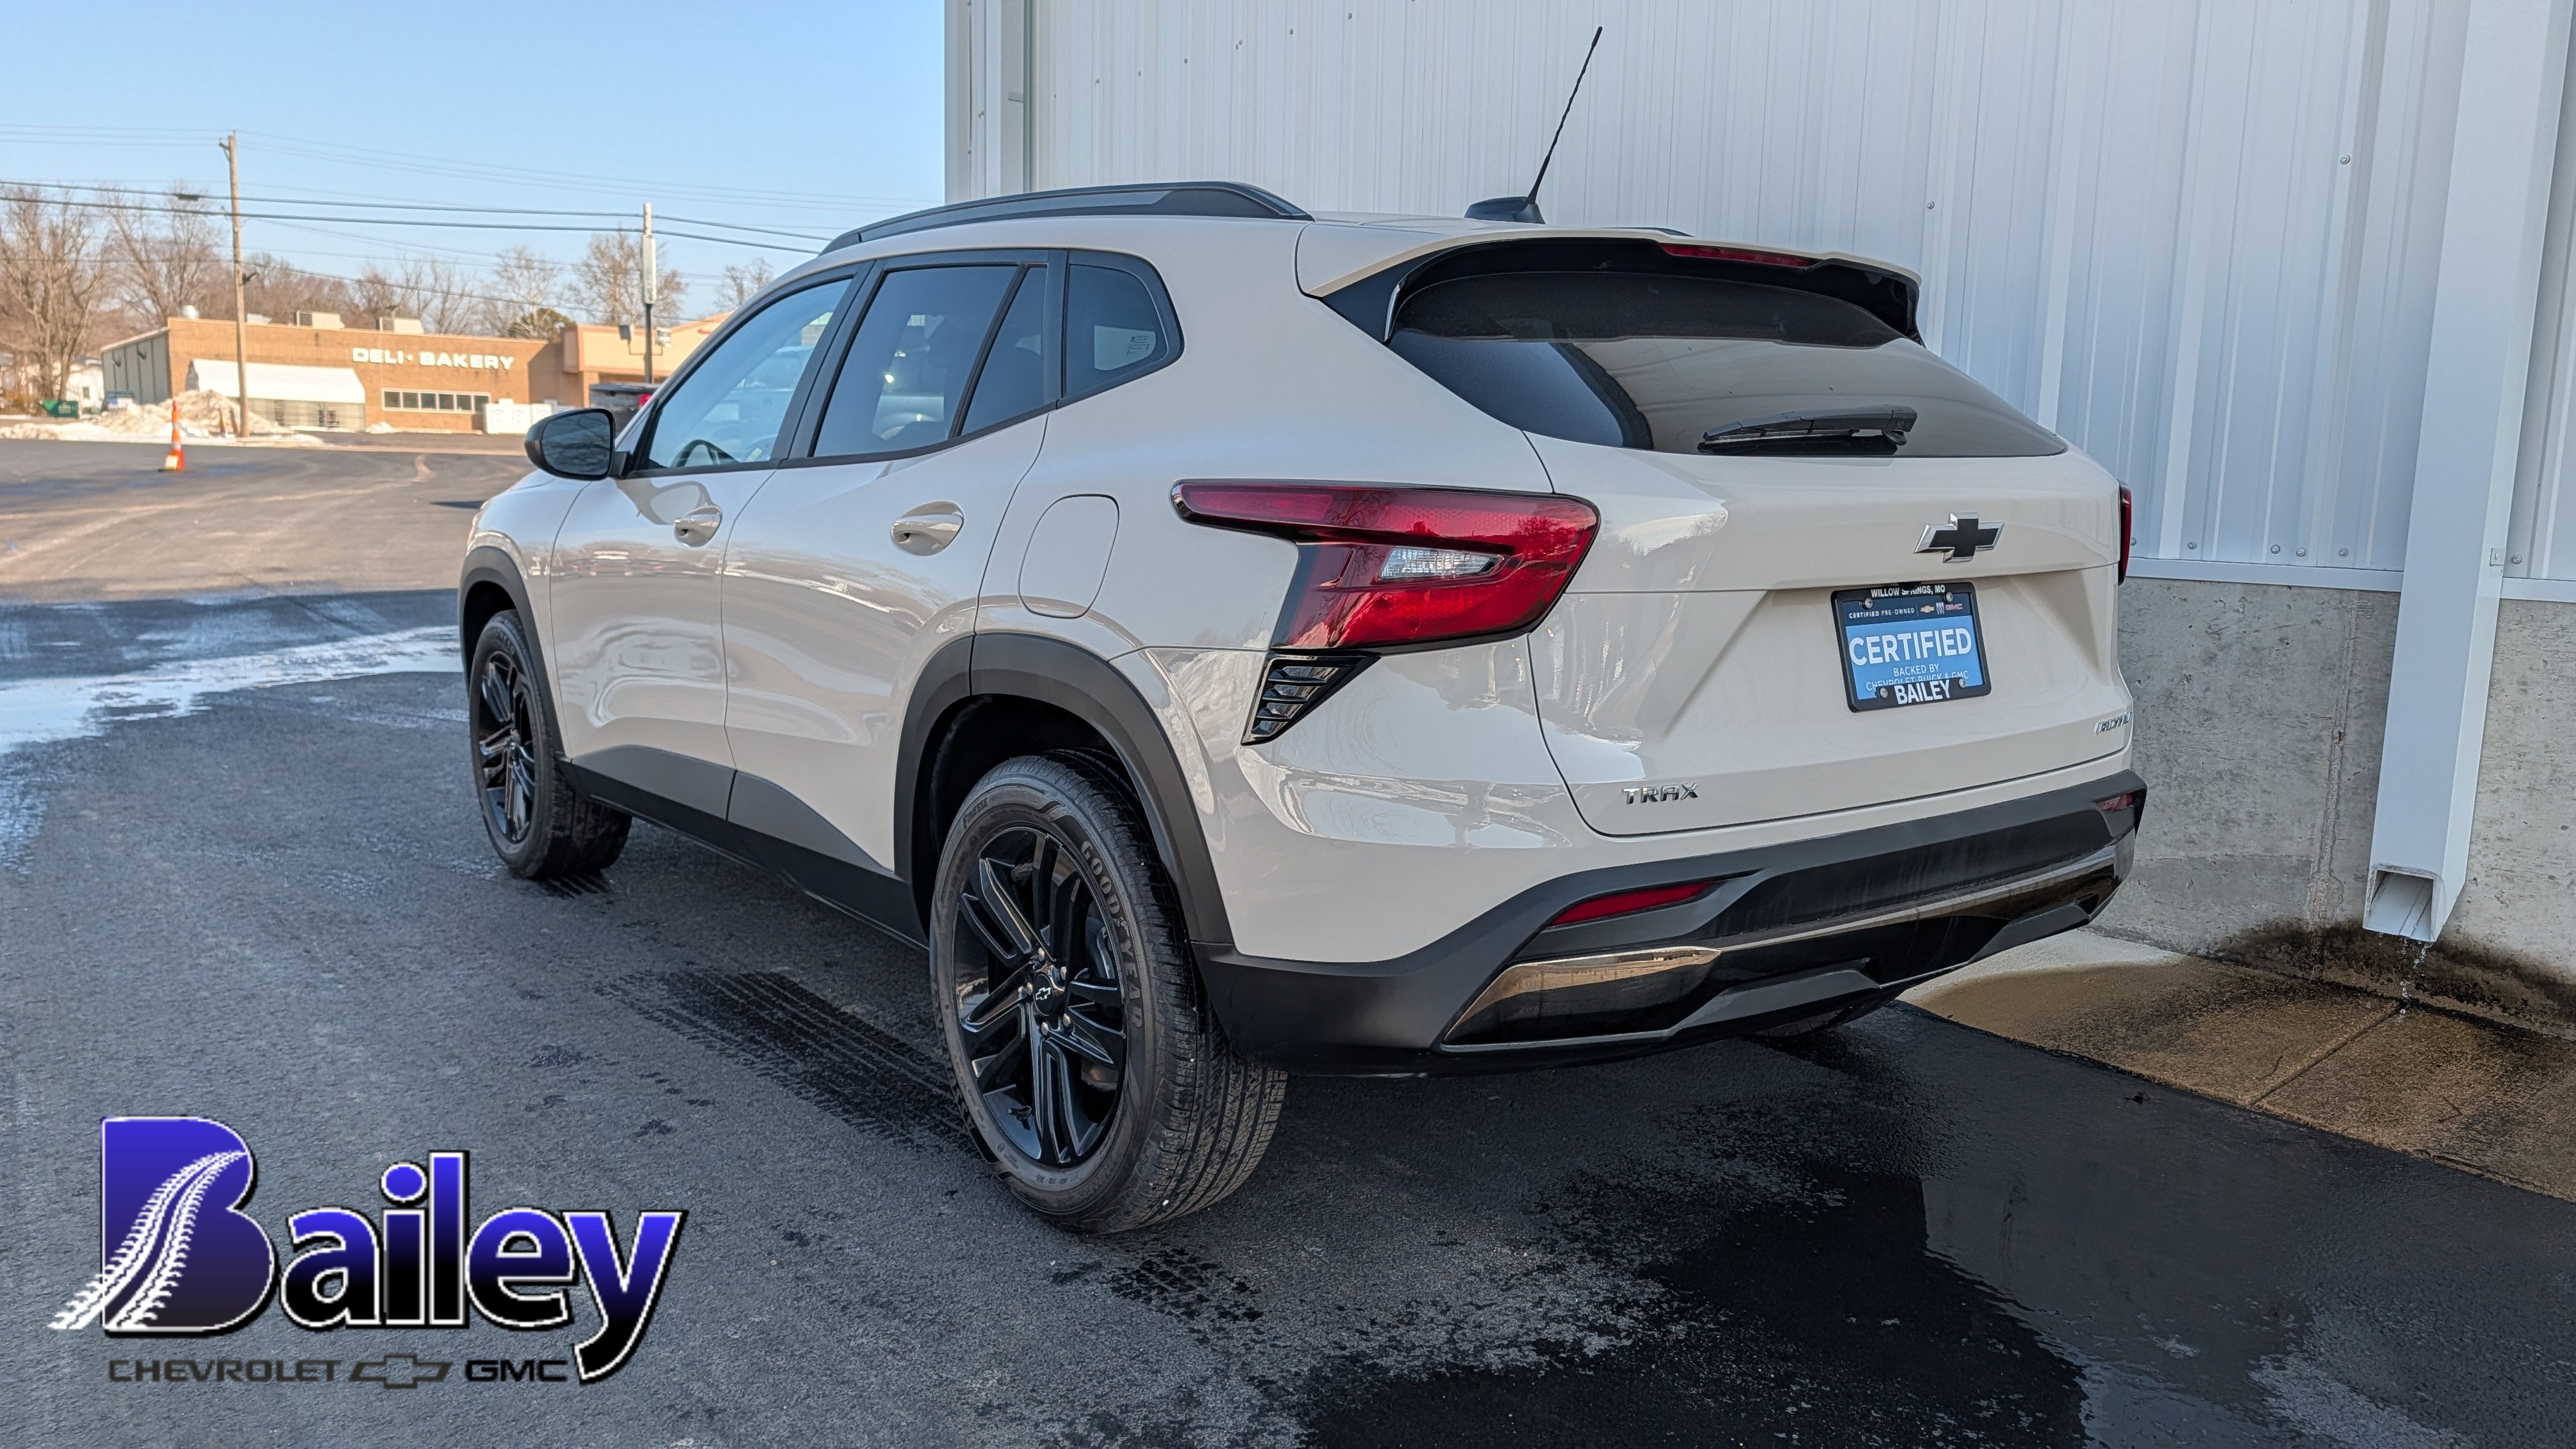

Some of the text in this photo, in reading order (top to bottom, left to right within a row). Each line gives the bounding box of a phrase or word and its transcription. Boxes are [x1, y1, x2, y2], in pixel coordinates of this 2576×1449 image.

[352, 347, 514, 371] DELI BAKERY
[1871, 587, 1900, 598] WILLOW
[1935, 584, 1946, 594] MO
[1849, 608, 1915, 618] CERTIFIED PRE-OWNED
[1848, 627, 1972, 666] CERTIFIED
[1893, 663, 1940, 677] BACKED BY
[1894, 679, 1951, 705] BAILEY
[1622, 782, 1699, 804] TRAX
[1081, 840, 1143, 1028] GOODYEAR
